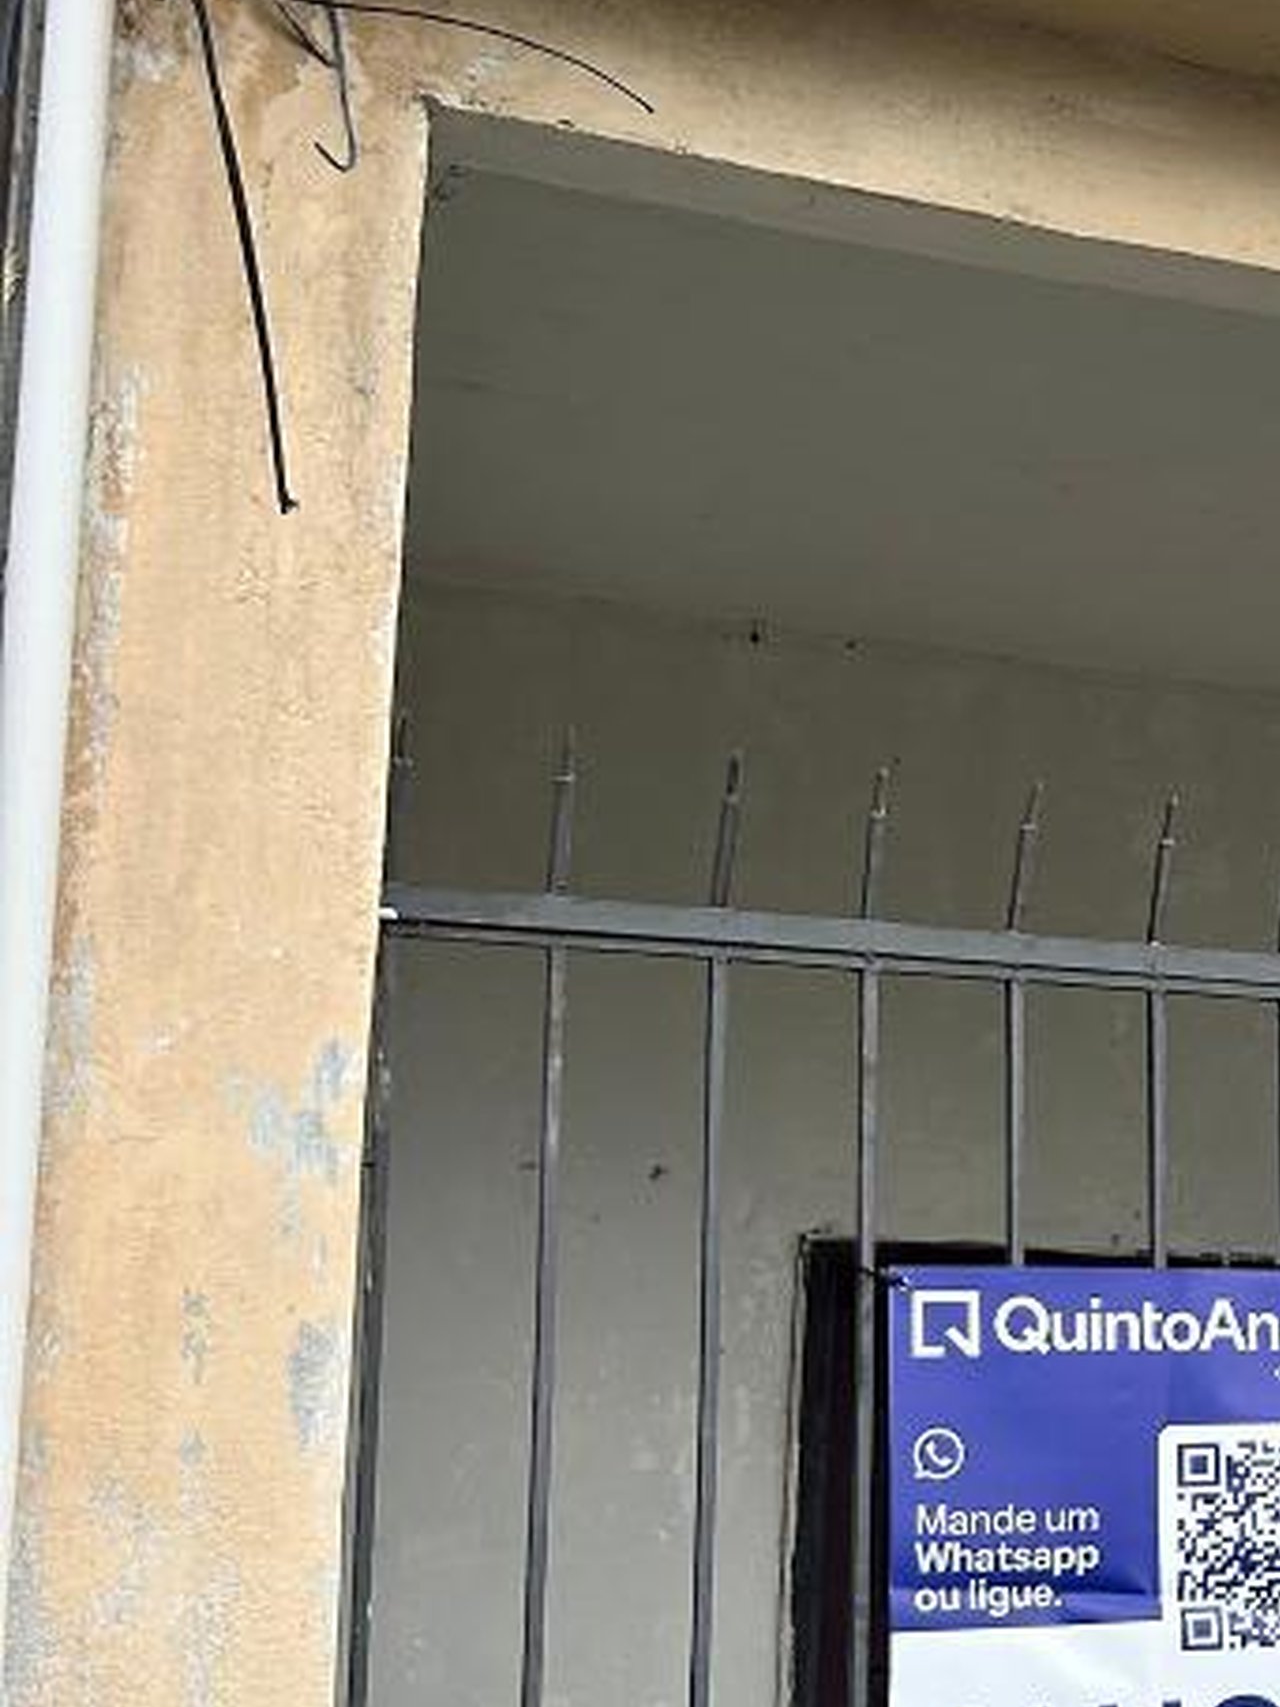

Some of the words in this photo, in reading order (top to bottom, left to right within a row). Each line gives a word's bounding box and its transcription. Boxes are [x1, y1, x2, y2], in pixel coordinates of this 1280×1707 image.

[914, 1503, 1040, 1536] Mande
[1045, 1506, 1099, 1533] um
[914, 1541, 1099, 1576] Whatsapp
[913, 1587, 961, 1612] ou
[968, 1579, 1063, 1616] ligue.
